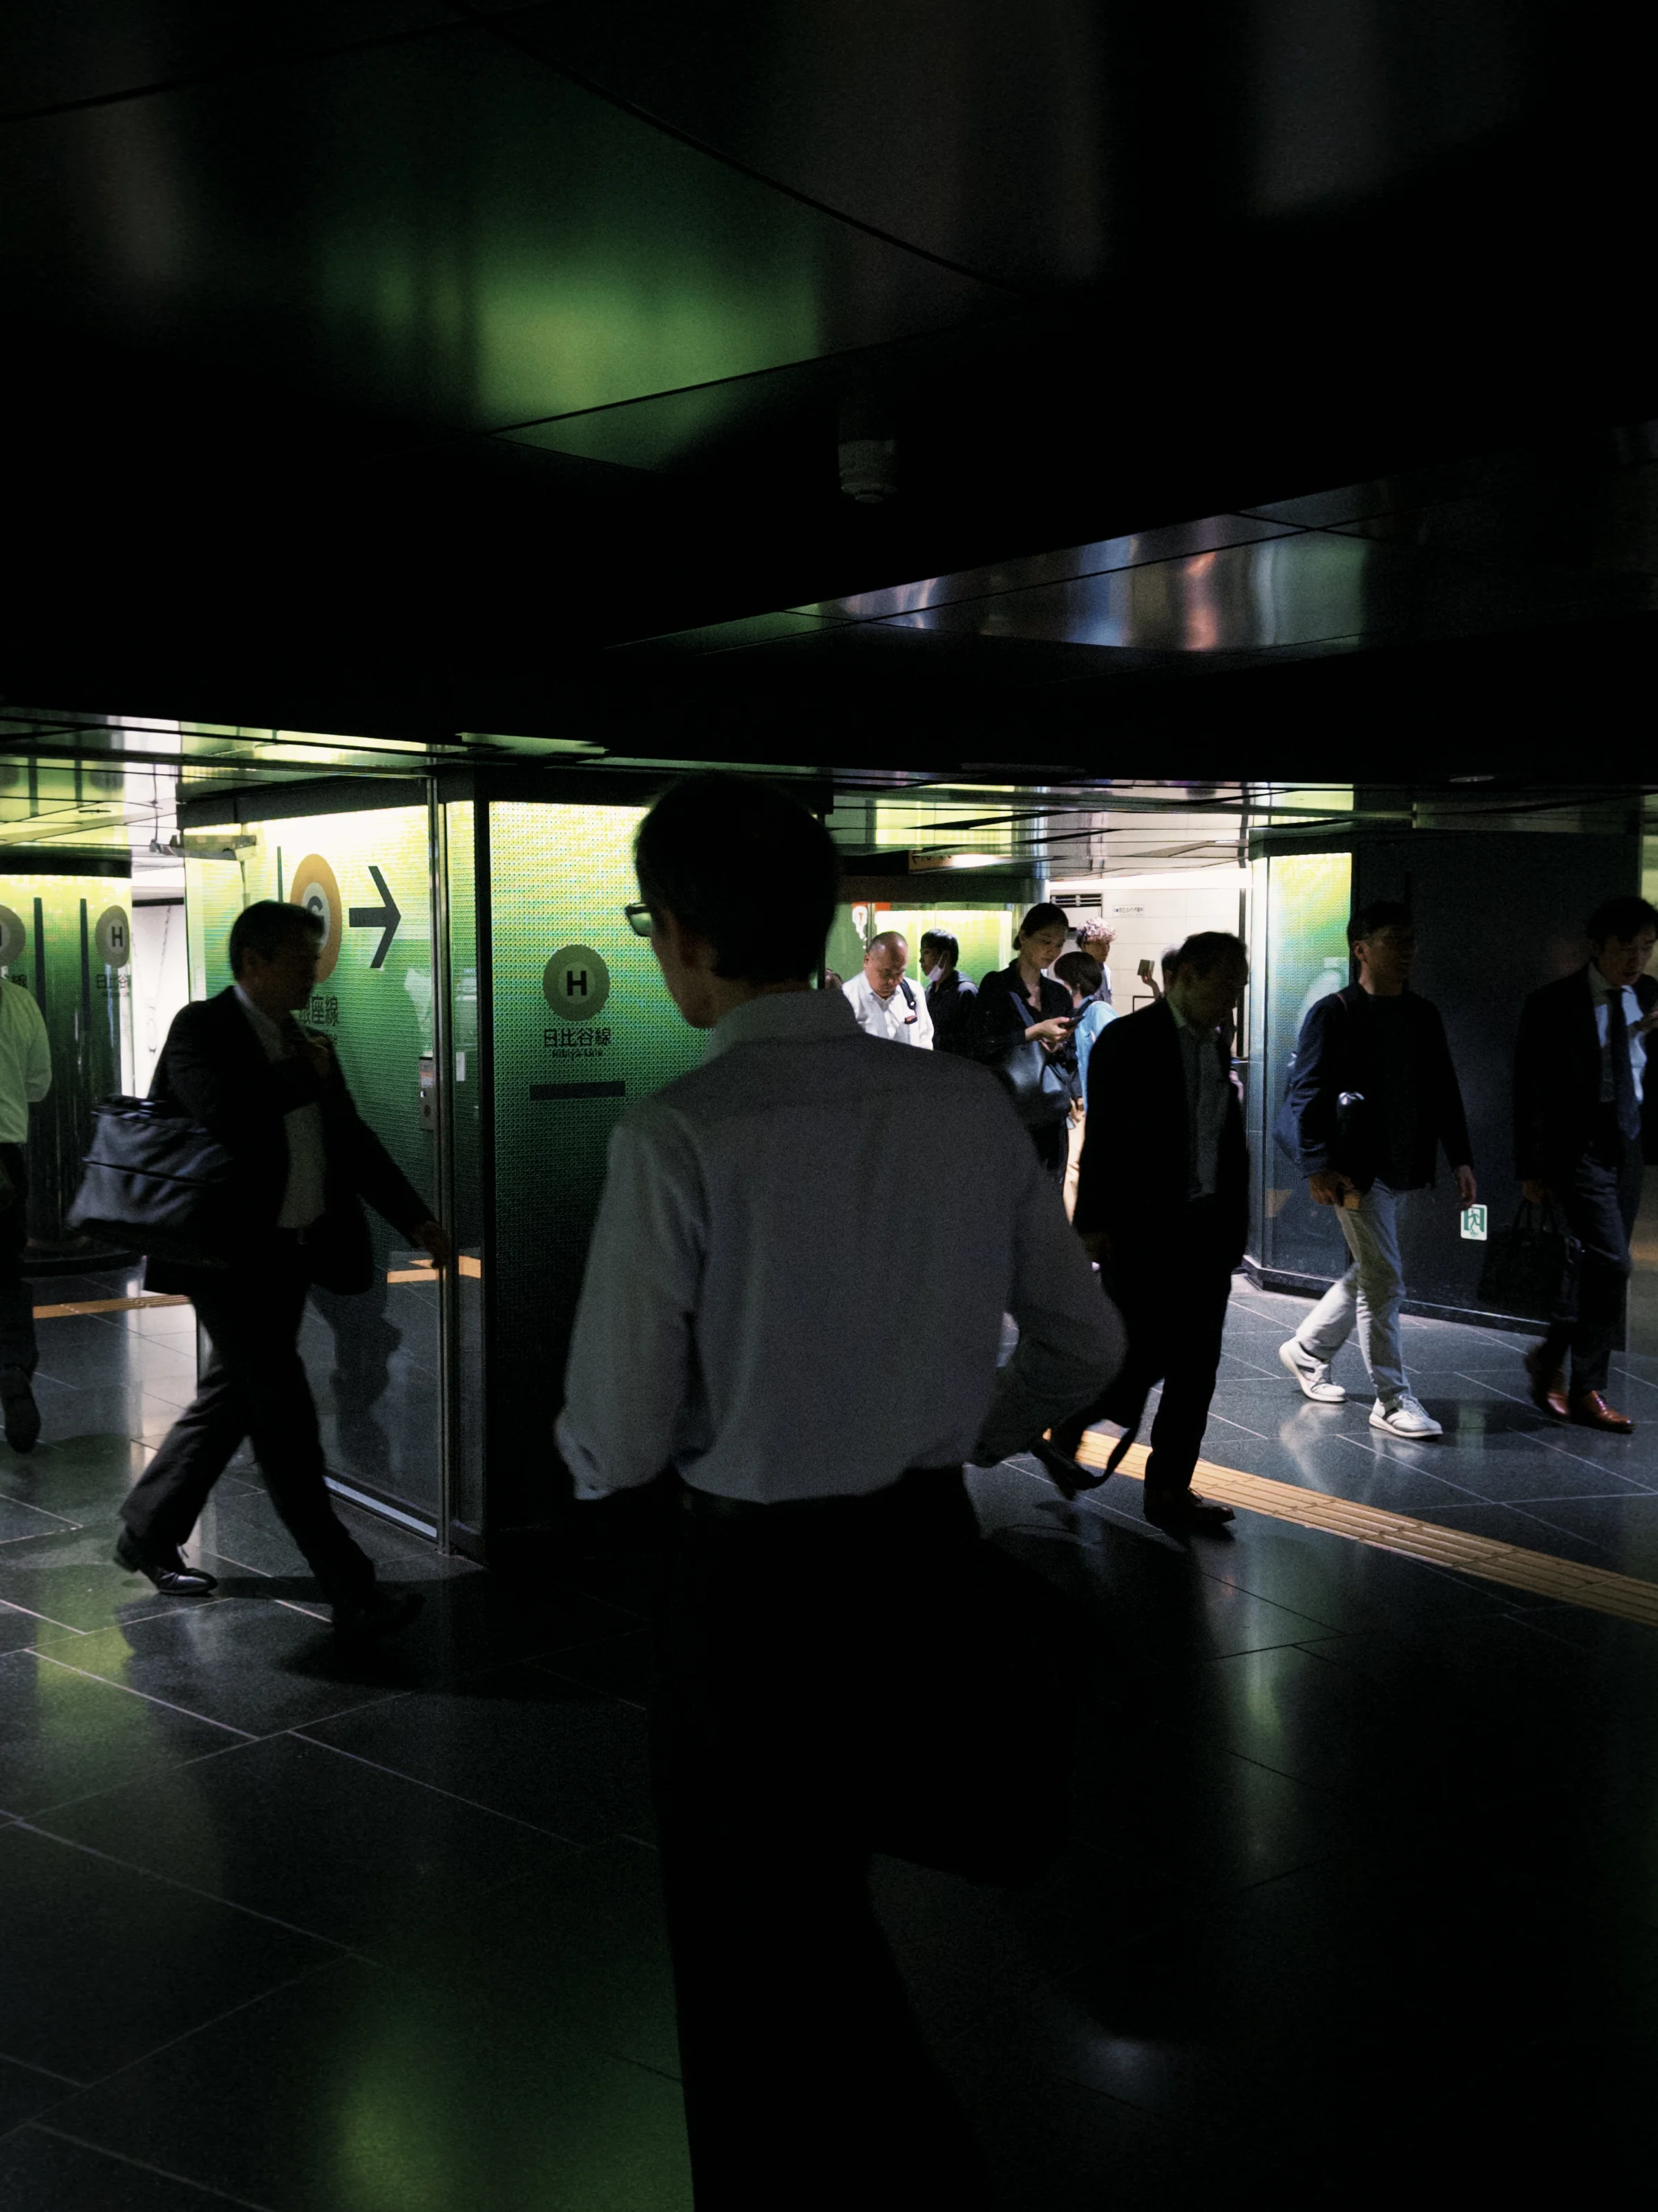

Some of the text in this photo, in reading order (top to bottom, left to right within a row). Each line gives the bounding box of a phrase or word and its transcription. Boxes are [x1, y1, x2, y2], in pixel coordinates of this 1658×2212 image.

[111, 926, 123, 947] H
[97, 974, 131, 990] 日比谷
[566, 970, 587, 996] H
[544, 1027, 611, 1048] 日比谷線
